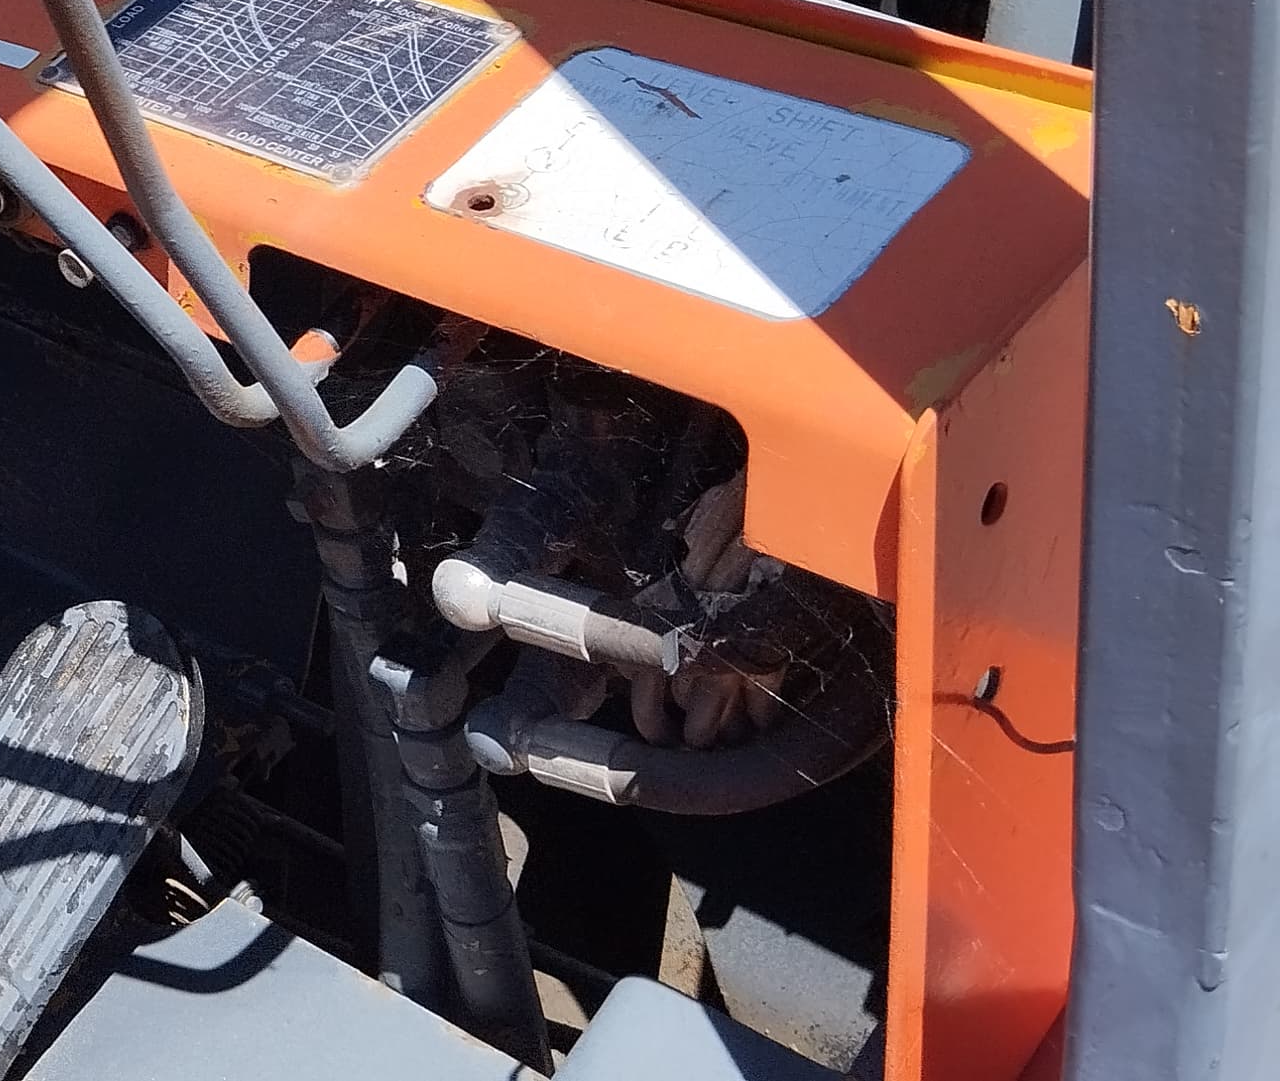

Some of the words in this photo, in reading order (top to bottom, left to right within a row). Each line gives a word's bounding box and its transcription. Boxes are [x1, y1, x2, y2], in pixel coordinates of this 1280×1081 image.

[111, 3, 146, 29] LOAD
[436, 20, 491, 40] FORKLIFT
[253, 48, 290, 76] LOAD
[133, 95, 173, 116] NTER
[767, 105, 865, 144] SHIFT
[226, 127, 266, 147] LOAD
[264, 141, 324, 167] CENTER
